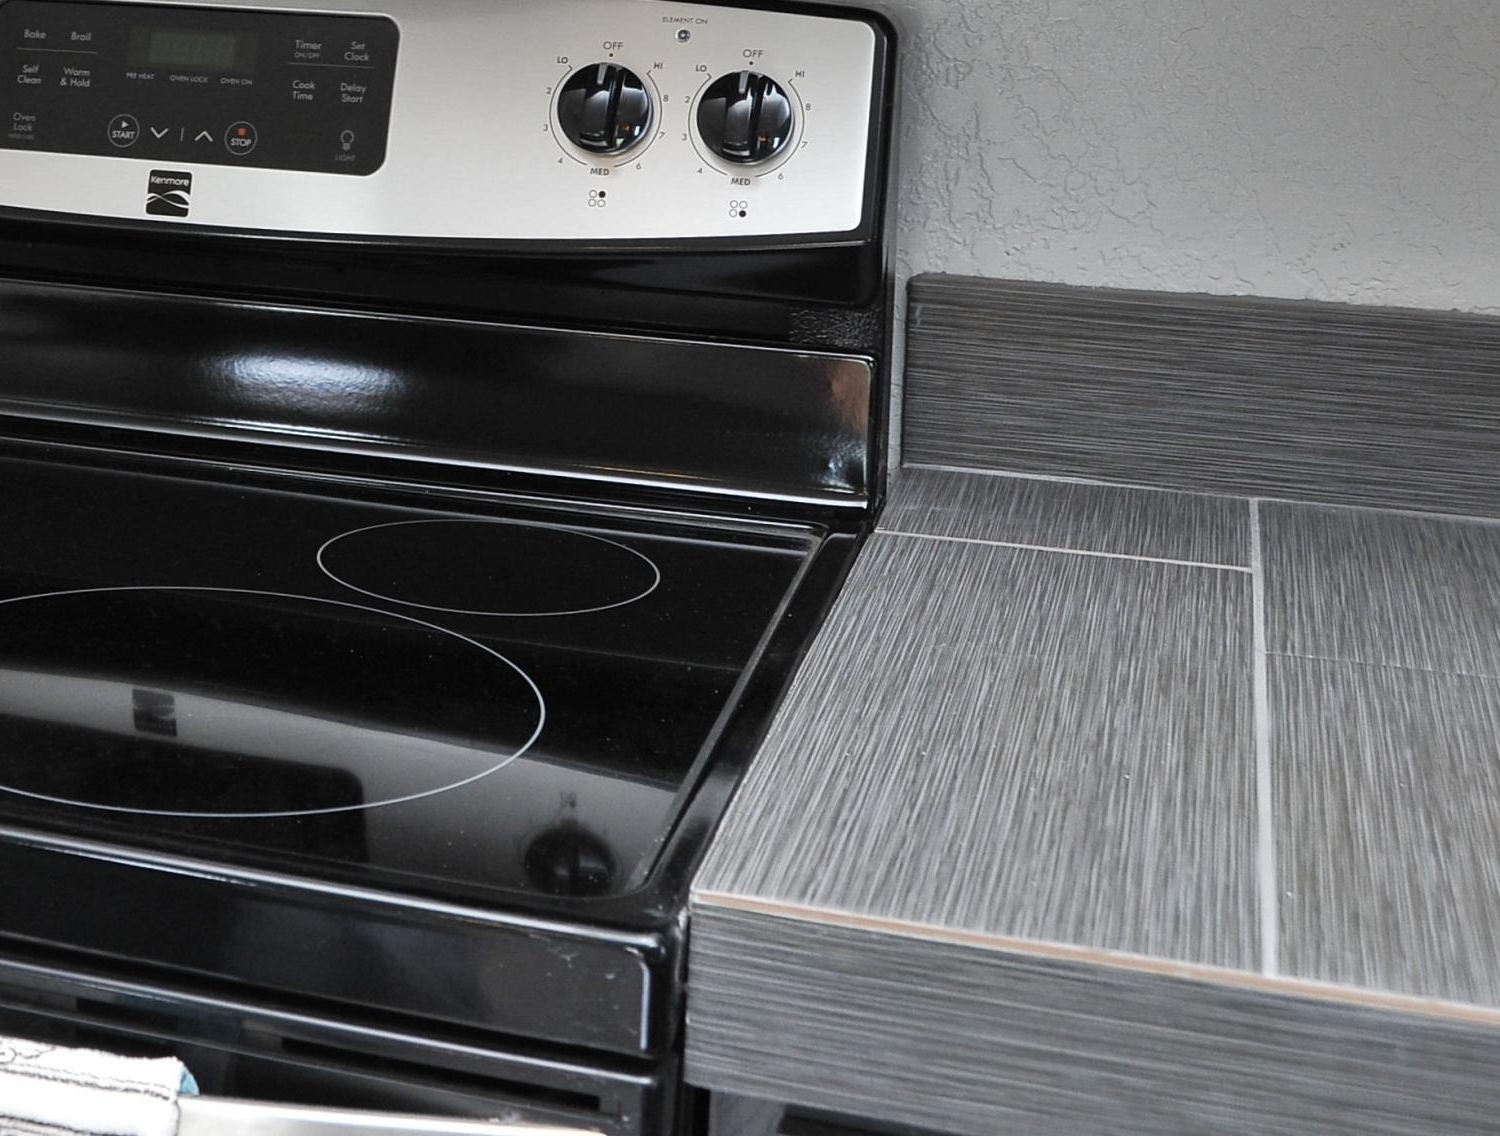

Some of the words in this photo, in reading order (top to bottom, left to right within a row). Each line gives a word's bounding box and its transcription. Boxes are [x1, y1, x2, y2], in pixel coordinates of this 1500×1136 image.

[24, 29, 47, 40] Bake
[70, 31, 92, 41] Broil
[295, 39, 322, 50] Timer
[350, 41, 366, 50] Set
[603, 41, 623, 50] OFF
[344, 52, 370, 62] Clock
[742, 49, 764, 58] OFF
[22, 64, 40, 74] Self
[63, 67, 90, 77] Warm
[695, 65, 707, 73] LO
[17, 75, 42, 85] Clean
[70, 78, 91, 87] Hold
[292, 80, 316, 90] Cook
[340, 82, 367, 94] Delay
[292, 91, 314, 101] Time
[341, 93, 363, 104] Start
[112, 129, 136, 139] START
[230, 137, 252, 147] STOP
[590, 167, 610, 176] MED
[151, 175, 189, 187] Kenmore
[731, 176, 751, 186] MED
